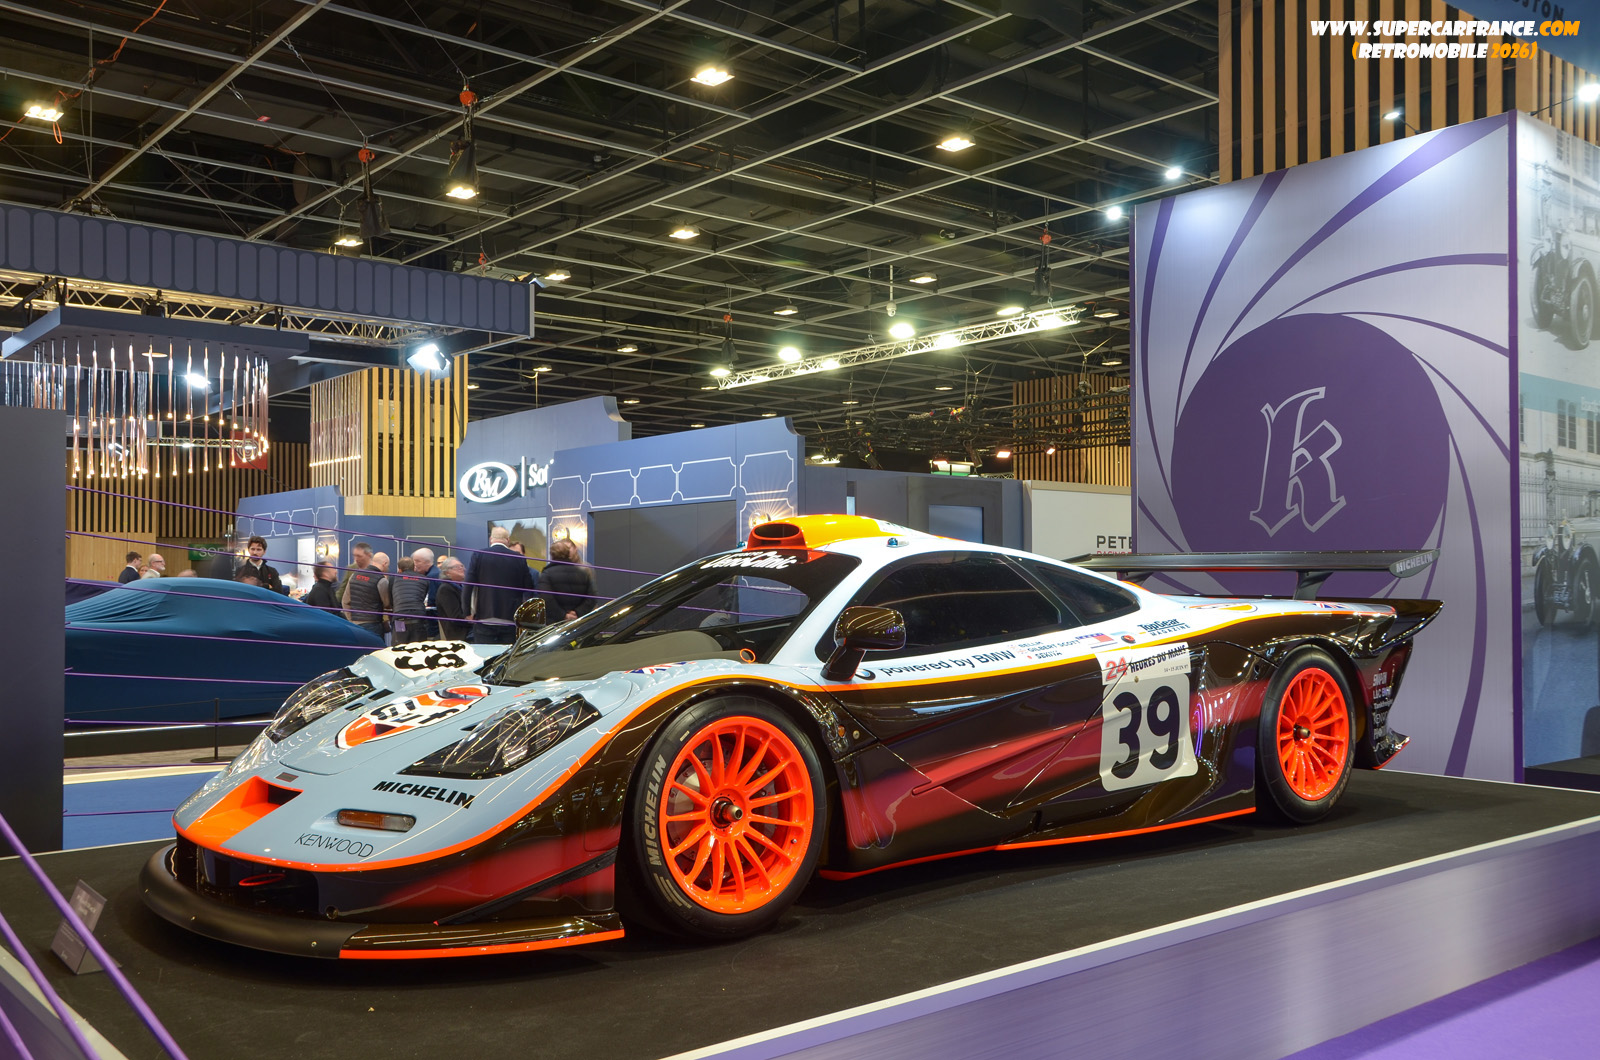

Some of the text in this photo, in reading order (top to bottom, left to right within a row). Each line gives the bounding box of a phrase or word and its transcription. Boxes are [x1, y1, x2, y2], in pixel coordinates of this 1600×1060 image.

[472, 468, 503, 498] RM
[1396, 552, 1433, 573] MICHELIN
[1150, 624, 1190, 636] MAGAZINE
[880, 649, 1016, 677] powered by BMW
[1105, 645, 1187, 681] 24 HEURES DU MANS
[1111, 686, 1180, 779] 39
[372, 781, 476, 809] MICHELIN
[644, 754, 667, 866] MICHELIN
[295, 833, 374, 858] KENWOOD
